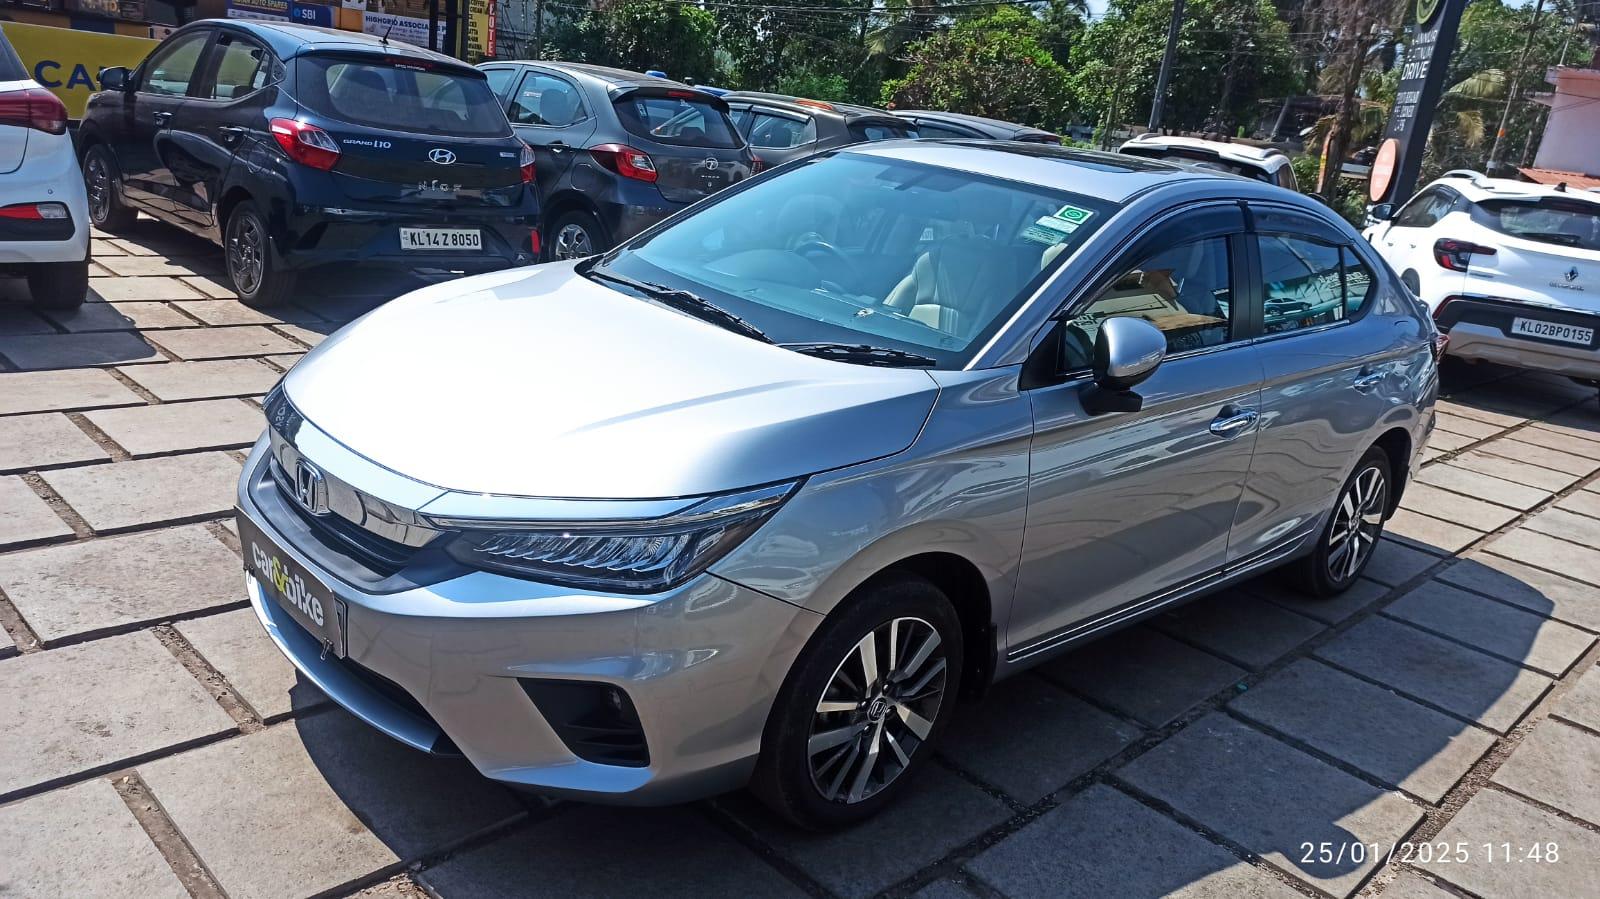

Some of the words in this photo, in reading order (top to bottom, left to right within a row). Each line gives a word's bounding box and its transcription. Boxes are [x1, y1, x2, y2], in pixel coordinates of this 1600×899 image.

[302, 9, 316, 20] SBI
[34, 60, 105, 91] CA
[1401, 61, 1430, 80] DRIVE
[409, 231, 439, 246] KL14
[451, 232, 479, 247] 8050
[1519, 320, 1593, 342] KL02BP0155
[252, 541, 324, 627] car&bike
